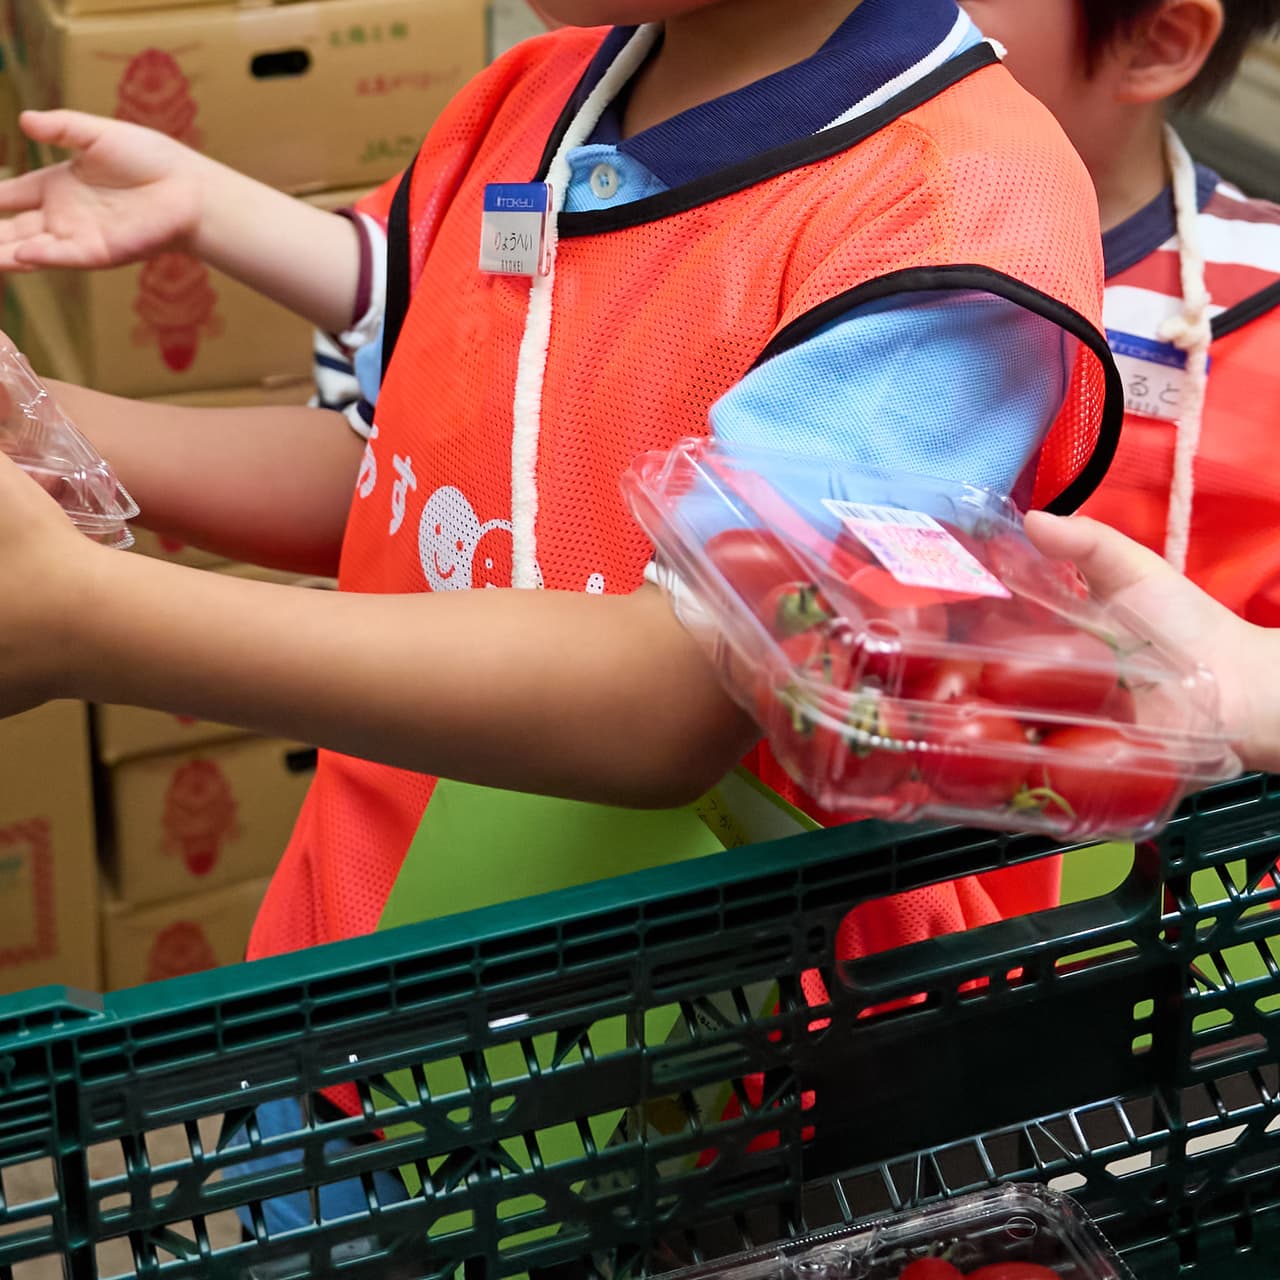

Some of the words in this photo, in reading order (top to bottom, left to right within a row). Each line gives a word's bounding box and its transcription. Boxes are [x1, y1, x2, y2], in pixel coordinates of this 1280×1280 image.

[495, 231, 533, 252] りょうへい
